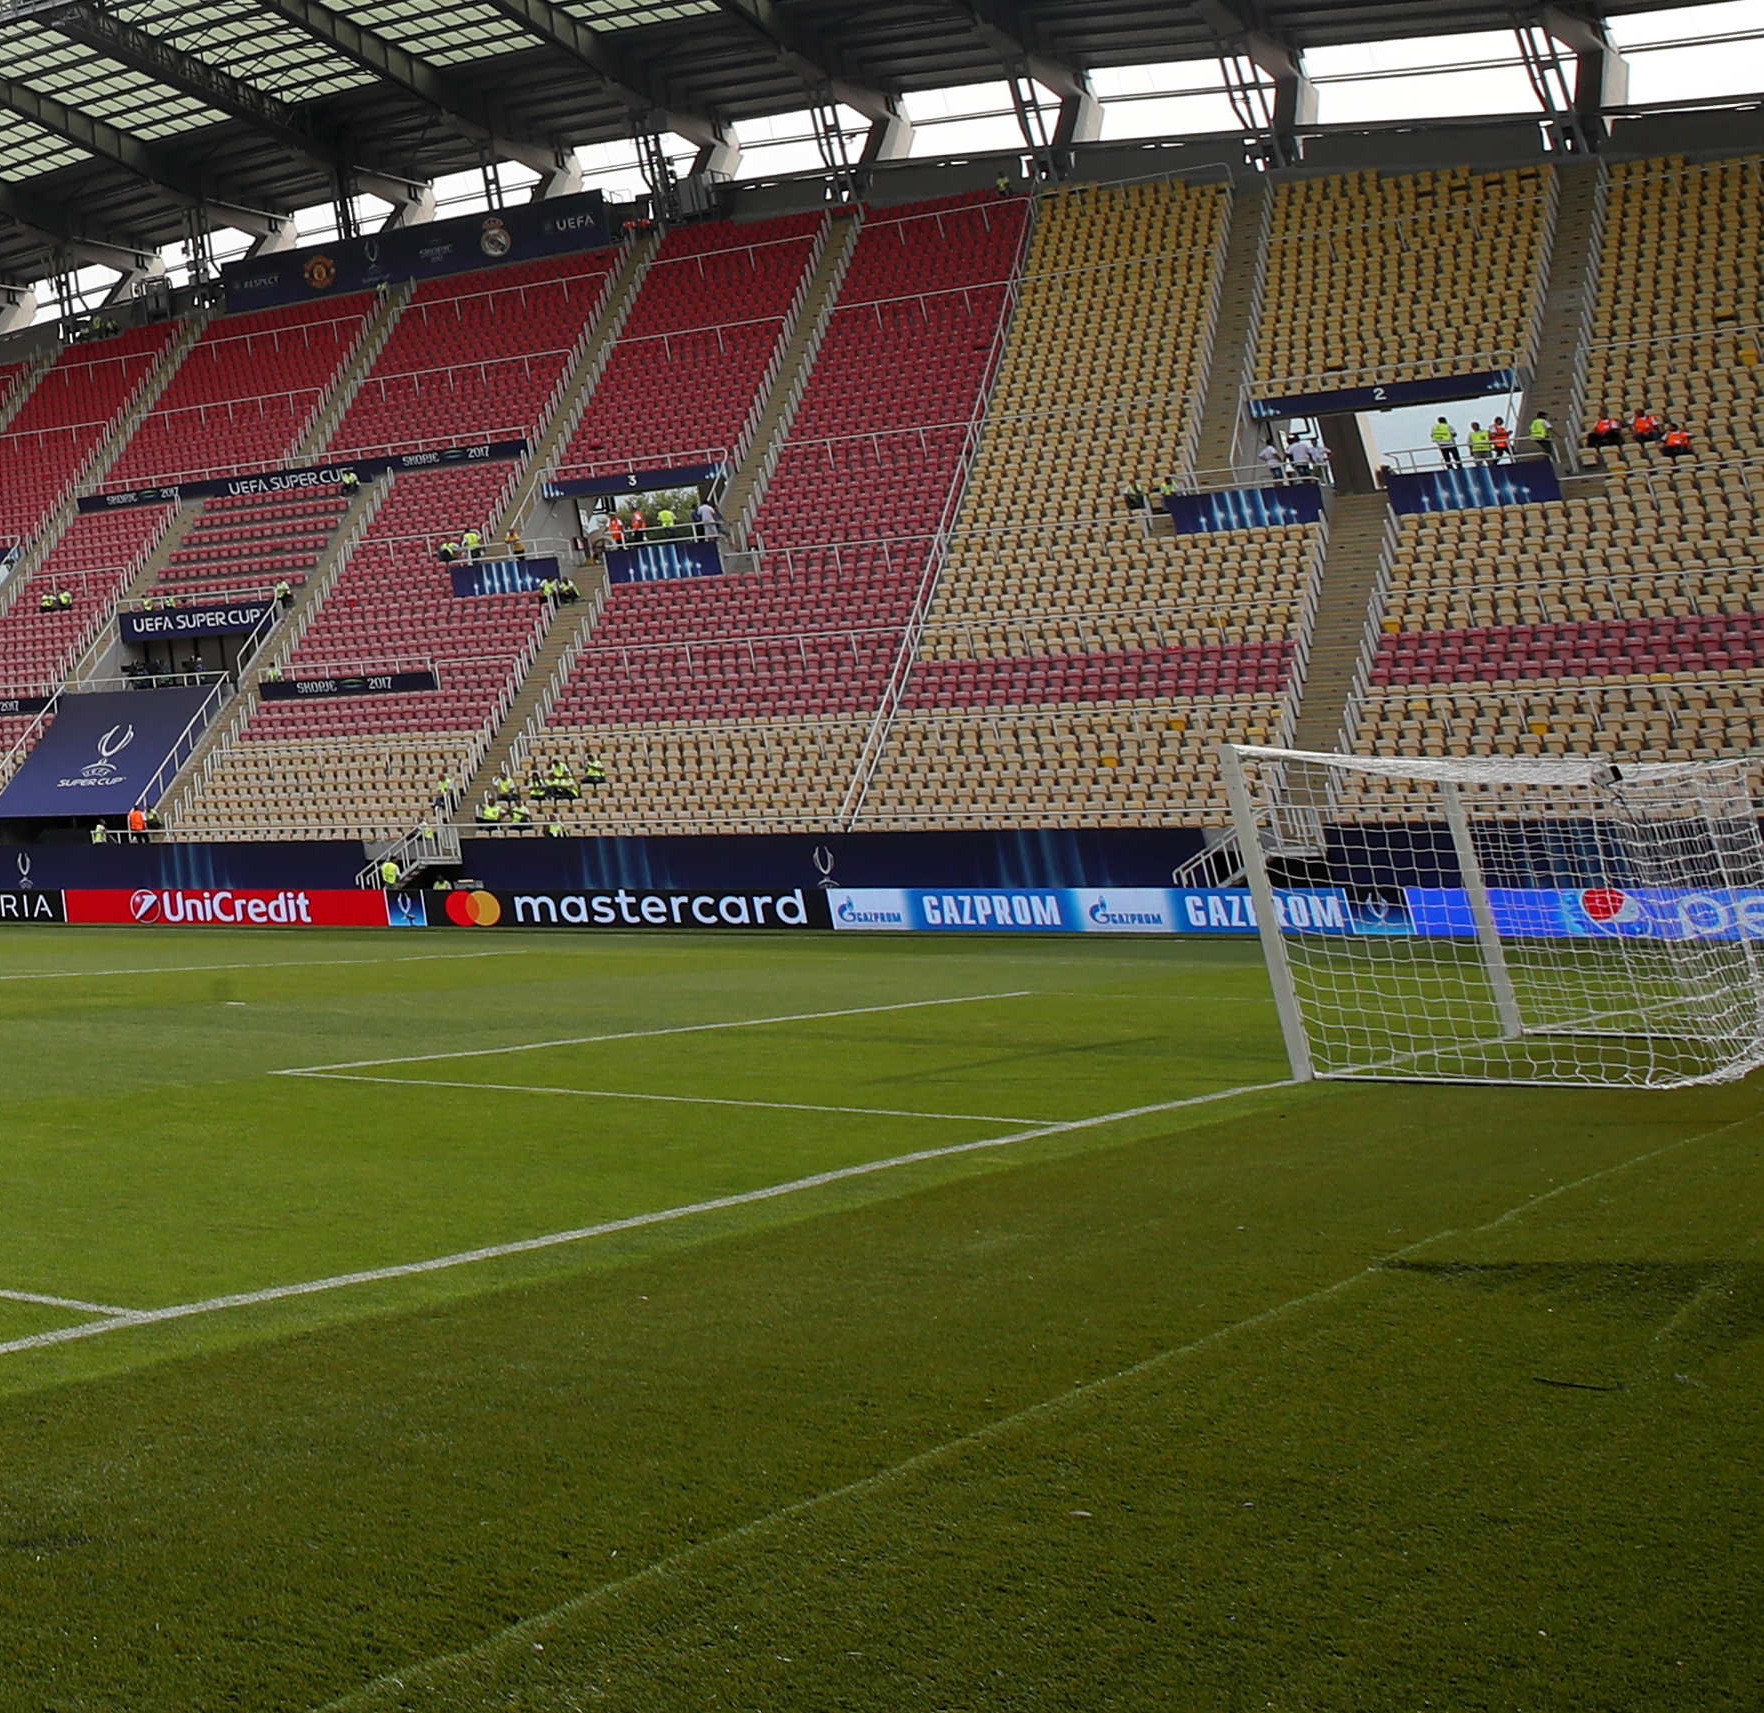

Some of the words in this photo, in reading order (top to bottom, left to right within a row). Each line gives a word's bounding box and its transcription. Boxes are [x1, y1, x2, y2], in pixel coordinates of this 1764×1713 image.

[555, 214, 596, 230] UEFA
[1373, 387, 1387, 401] 2
[402, 451, 440, 467] SKOPJE
[466, 445, 490, 458] 2017
[228, 477, 269, 496] UEFA
[270, 471, 319, 491] SUPER
[627, 474, 637, 487] 3
[106, 493, 138, 506] SKOPJE
[160, 486, 180, 499] 2017
[133, 615, 174, 633] UEFA
[175, 611, 228, 630] SUPER
[228, 607, 261, 625] CUP
[296, 679, 338, 694] SKOPJE
[366, 676, 393, 690] 2017
[0, 700, 20, 713] 2017
[56, 778, 97, 787] SUPER
[97, 777, 124, 786] CUP
[162, 890, 313, 923] UniCredit
[513, 888, 809, 925] mastercard
[922, 894, 1062, 926] GAZPROM
[855, 912, 903, 924] GAZPROM
[1109, 913, 1163, 926] GAZPROM
